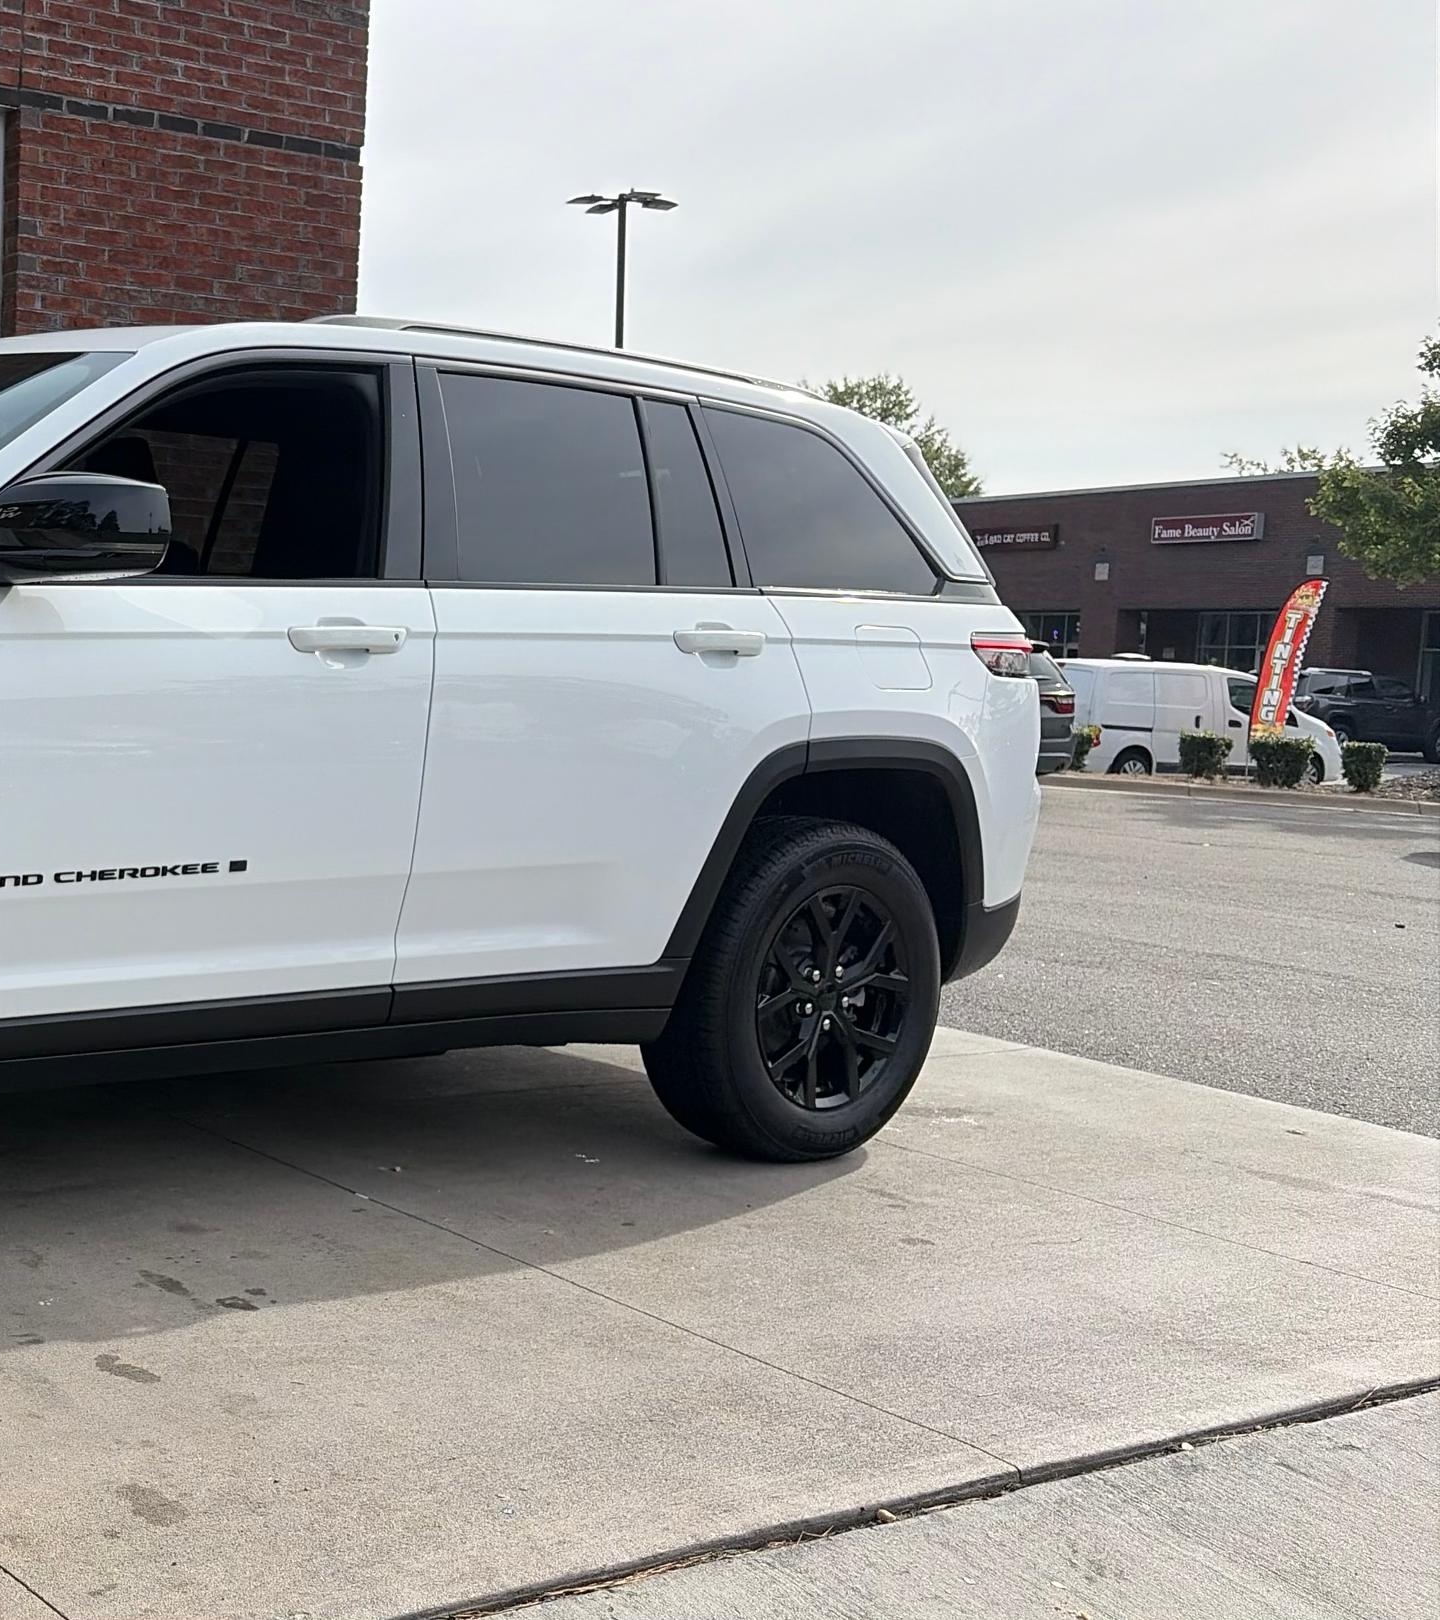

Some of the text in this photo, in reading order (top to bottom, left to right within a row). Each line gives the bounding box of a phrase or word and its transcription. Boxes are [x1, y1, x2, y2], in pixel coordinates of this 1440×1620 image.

[1016, 532, 1039, 543] COFFEE
[1154, 521, 1252, 540] Fame Beauty Salon
[1258, 610, 1305, 724] TINTING
[53, 861, 220, 884] CHEROKEE
